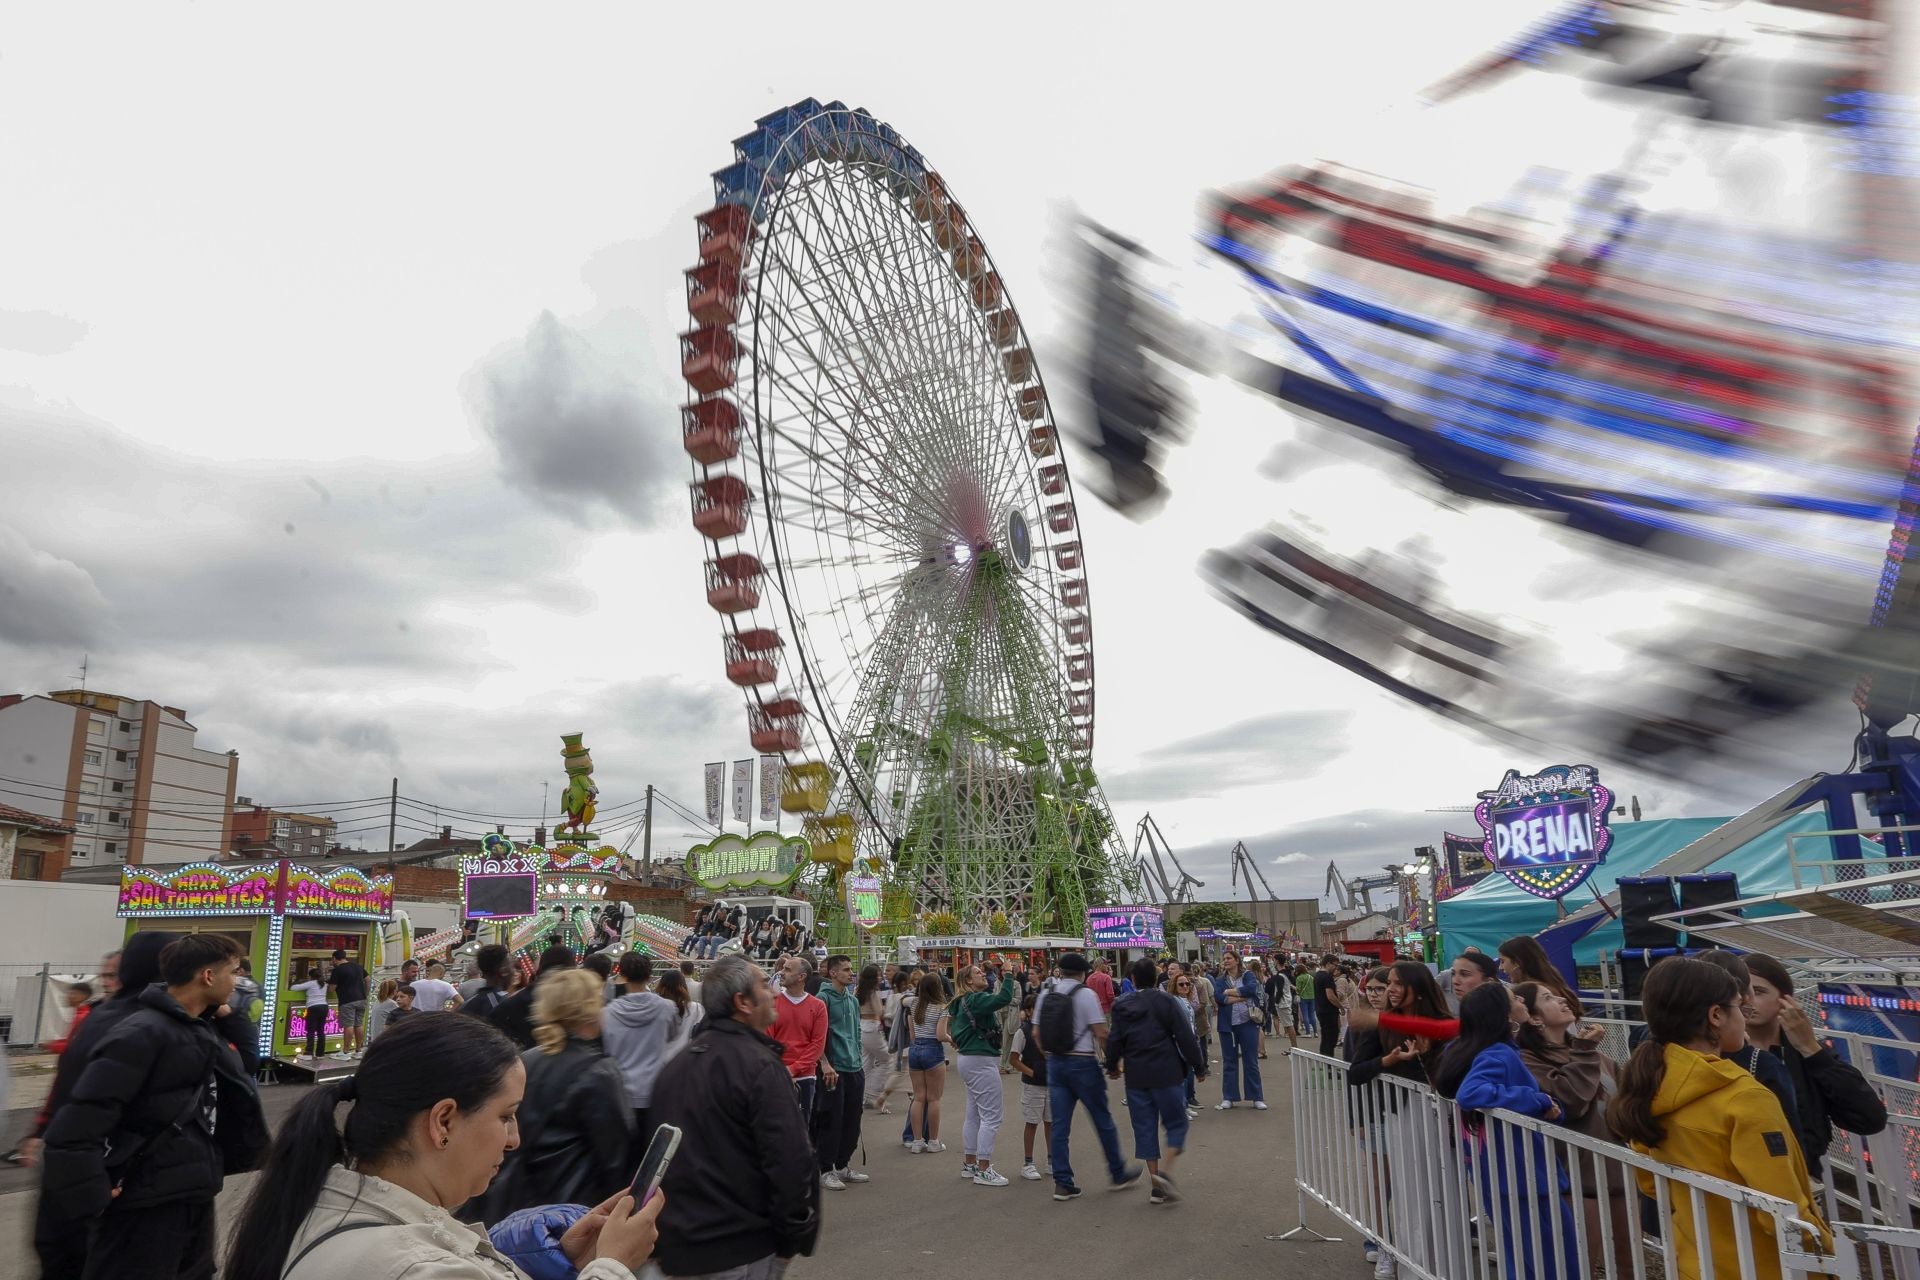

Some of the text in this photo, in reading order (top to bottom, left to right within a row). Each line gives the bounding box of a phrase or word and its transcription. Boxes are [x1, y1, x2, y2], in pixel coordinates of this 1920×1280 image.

[463, 857, 537, 874] MAXX
[129, 877, 266, 910] SALTAMONTES
[1092, 915, 1127, 930] NORIA
